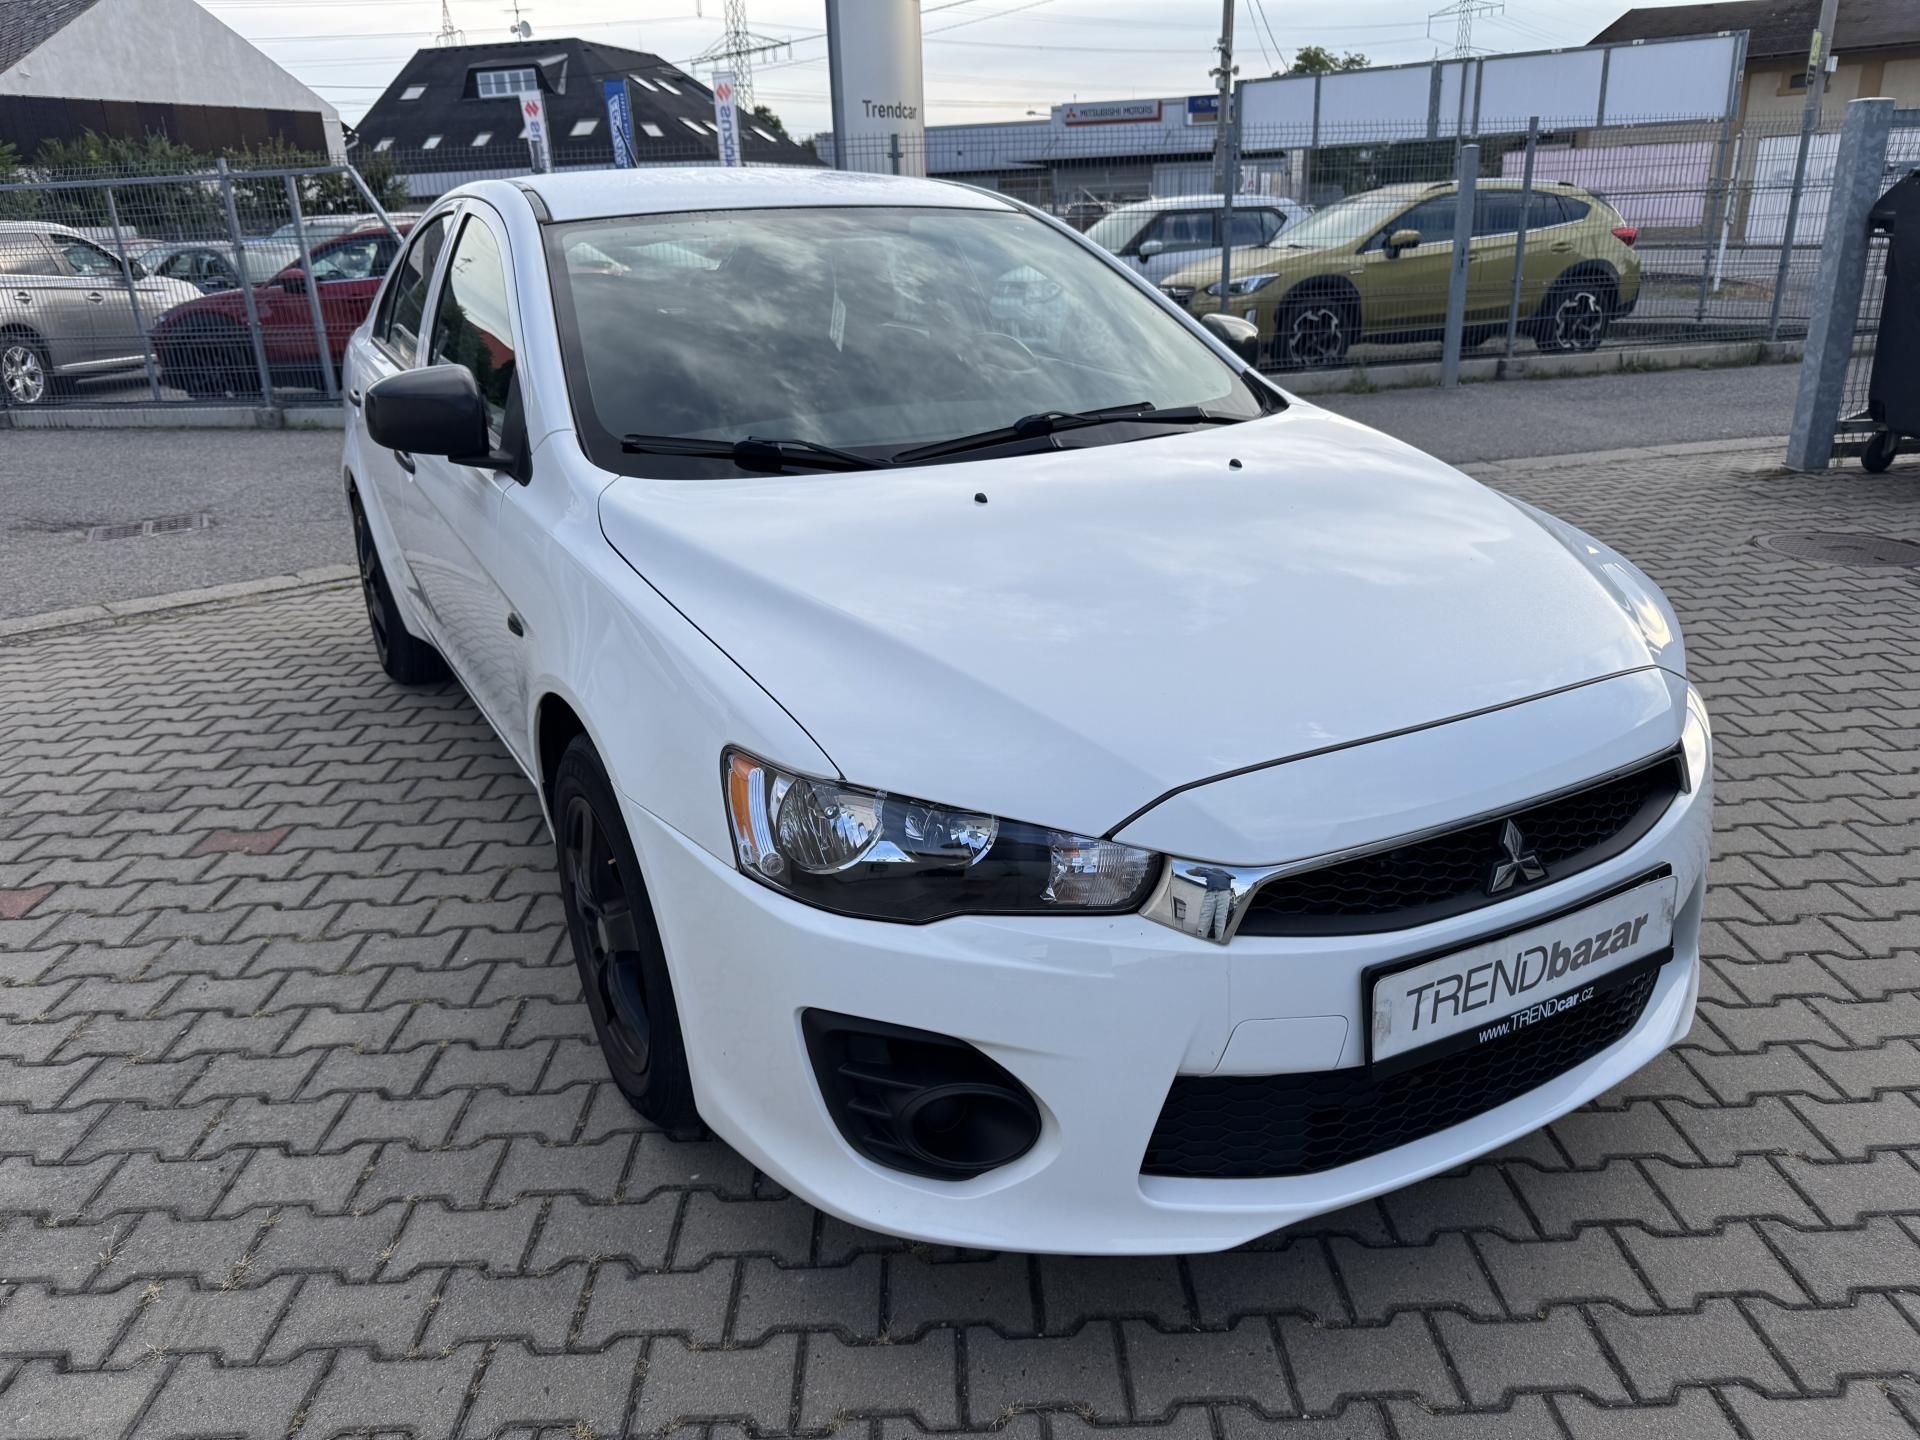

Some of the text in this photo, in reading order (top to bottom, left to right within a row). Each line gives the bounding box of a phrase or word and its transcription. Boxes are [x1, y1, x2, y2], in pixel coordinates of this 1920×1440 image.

[862, 100, 917, 119] Trendcar
[1079, 105, 1153, 118] MITSUBISHI MOTORS
[1406, 913, 1649, 1031] TRENDbazar
[1479, 987, 1594, 1043] www.TRENDcar.cz
